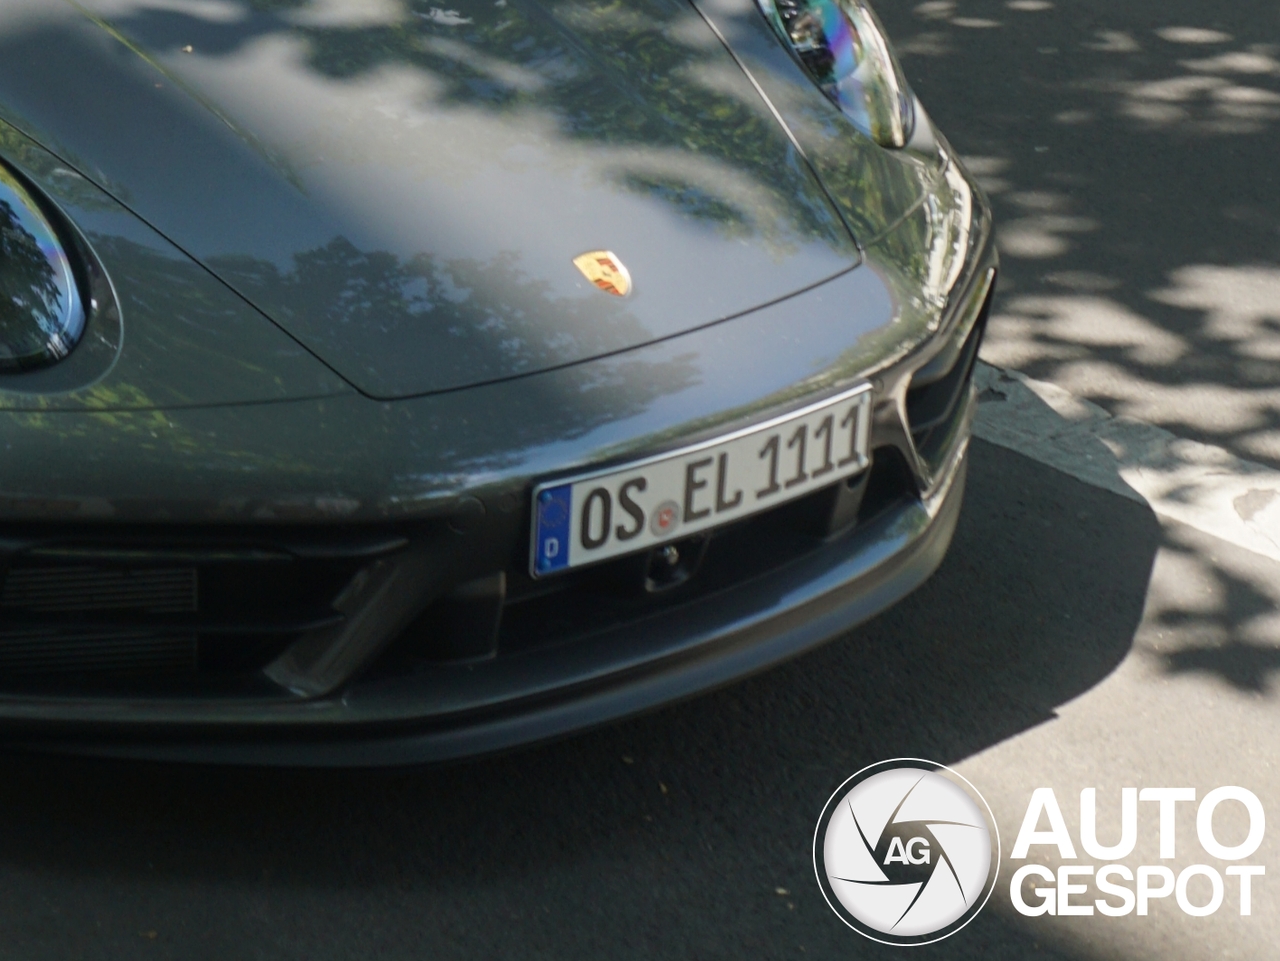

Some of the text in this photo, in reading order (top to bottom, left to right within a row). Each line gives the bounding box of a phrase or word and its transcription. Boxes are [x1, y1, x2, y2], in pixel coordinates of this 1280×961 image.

[580, 405, 861, 550] OS EL 1111
[544, 537, 560, 559] D
